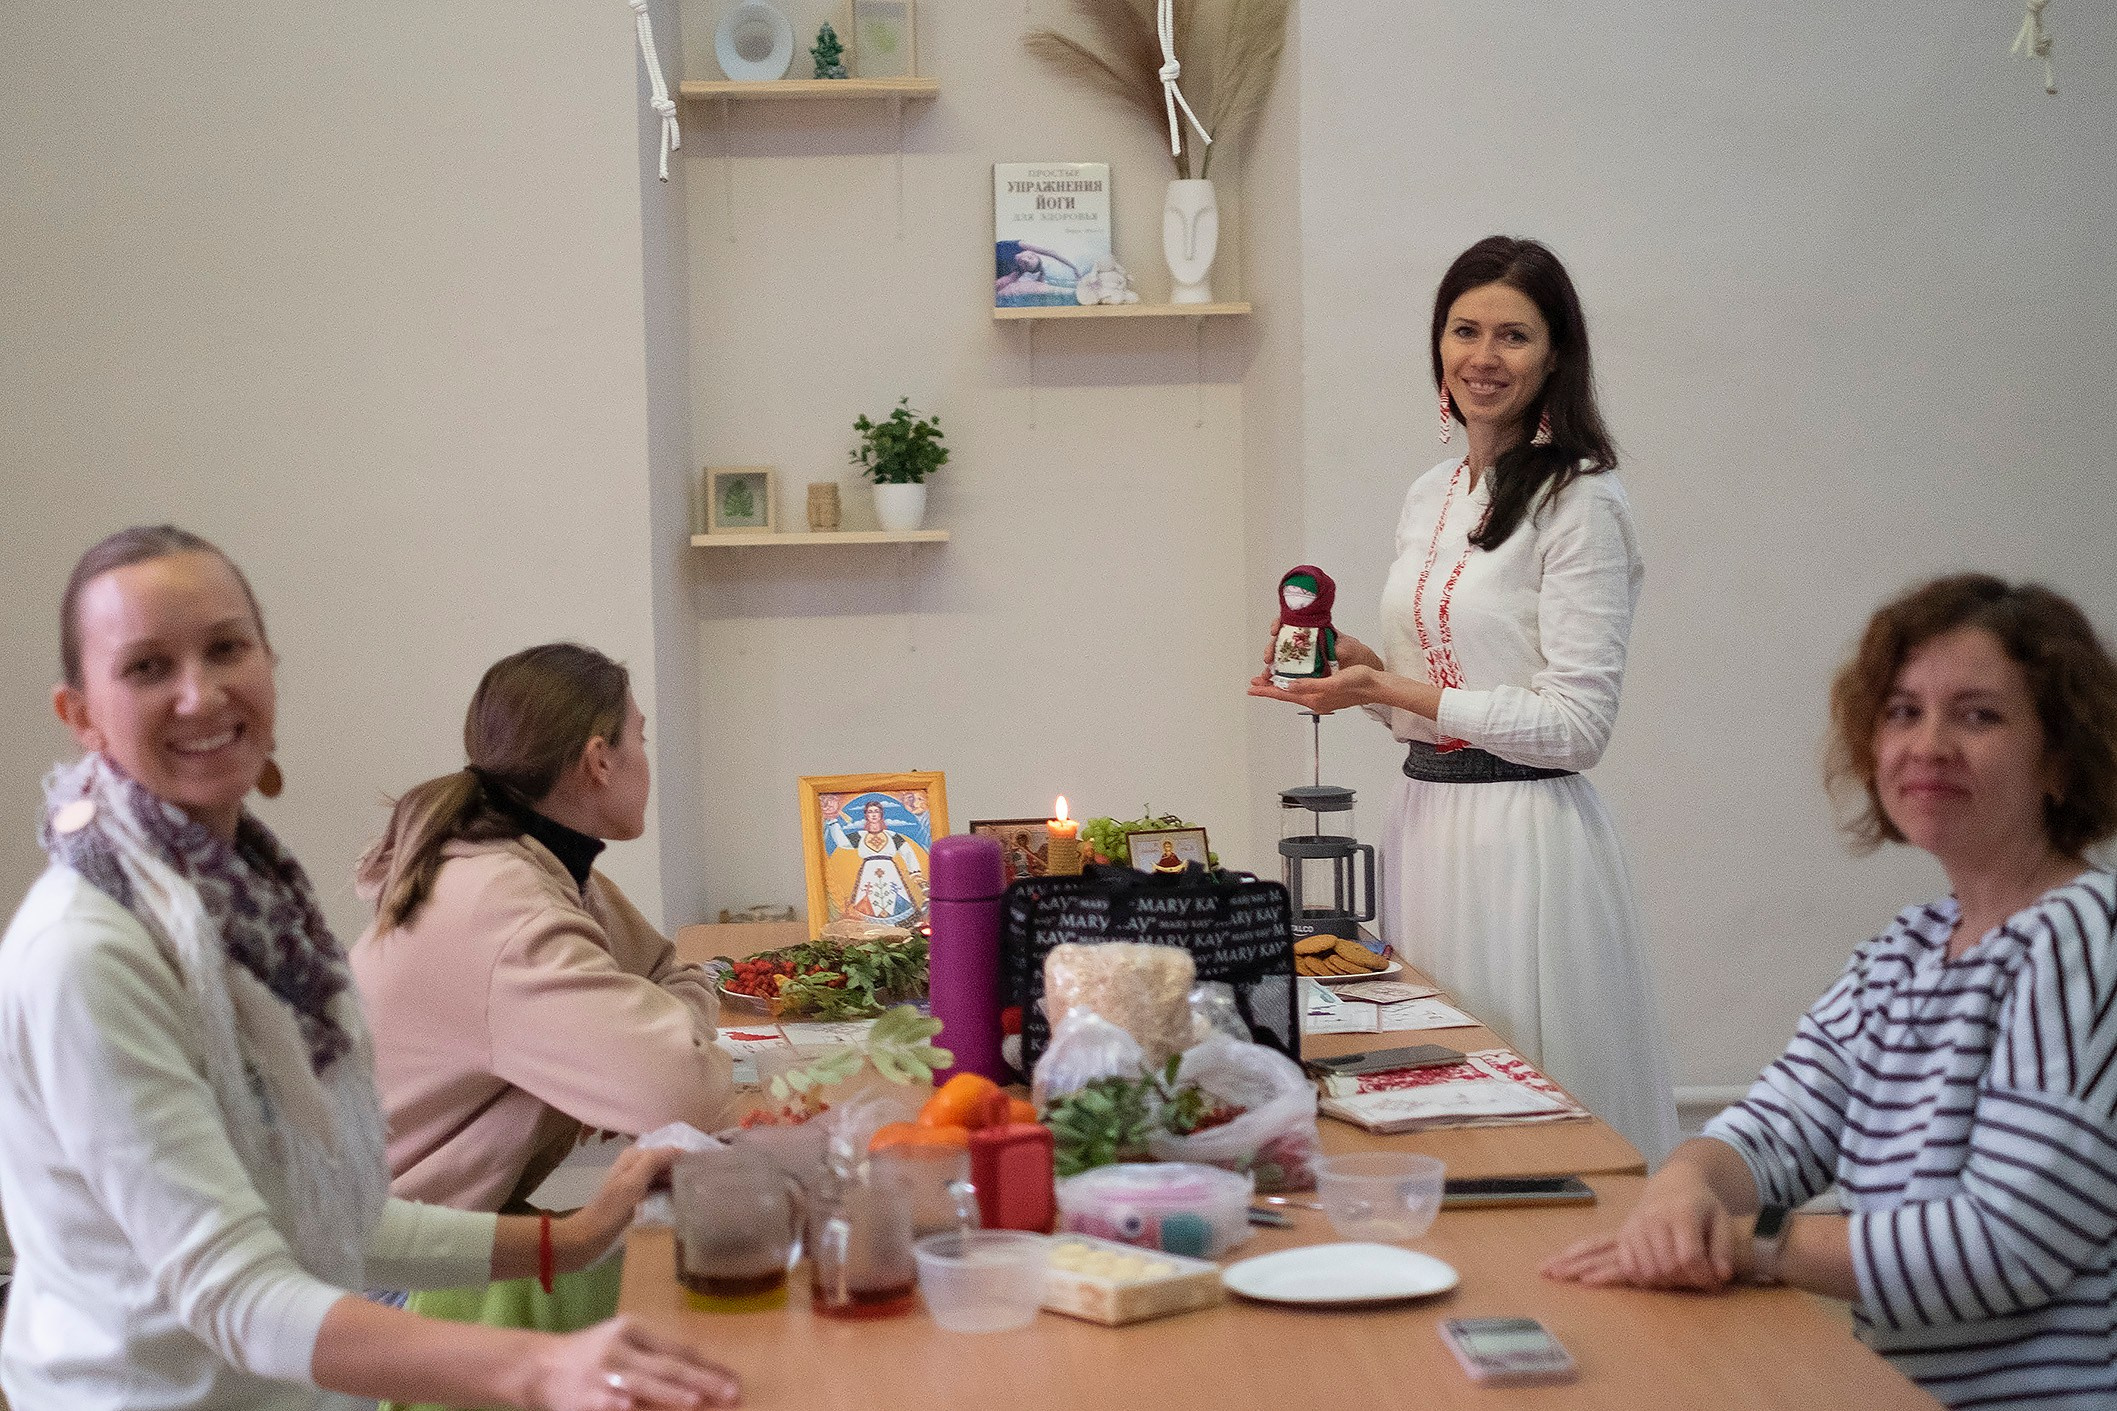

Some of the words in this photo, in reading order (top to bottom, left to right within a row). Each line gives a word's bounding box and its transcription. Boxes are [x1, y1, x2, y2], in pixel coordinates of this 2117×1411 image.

[1028, 169, 1079, 178] ПРОСТЫЕ
[1008, 181, 1102, 192] УПРАЖНЕНИЯ
[1036, 195, 1075, 209] ЙОГИ
[1013, 213, 1034, 221] ДЛЯ
[1041, 213, 1098, 221] ЗДОРОВЬЯ
[1137, 898, 1191, 915] MARY
[1195, 897, 1218, 911] KA
[1059, 914, 1109, 932] MARY
[1214, 945, 1257, 962] MARY
